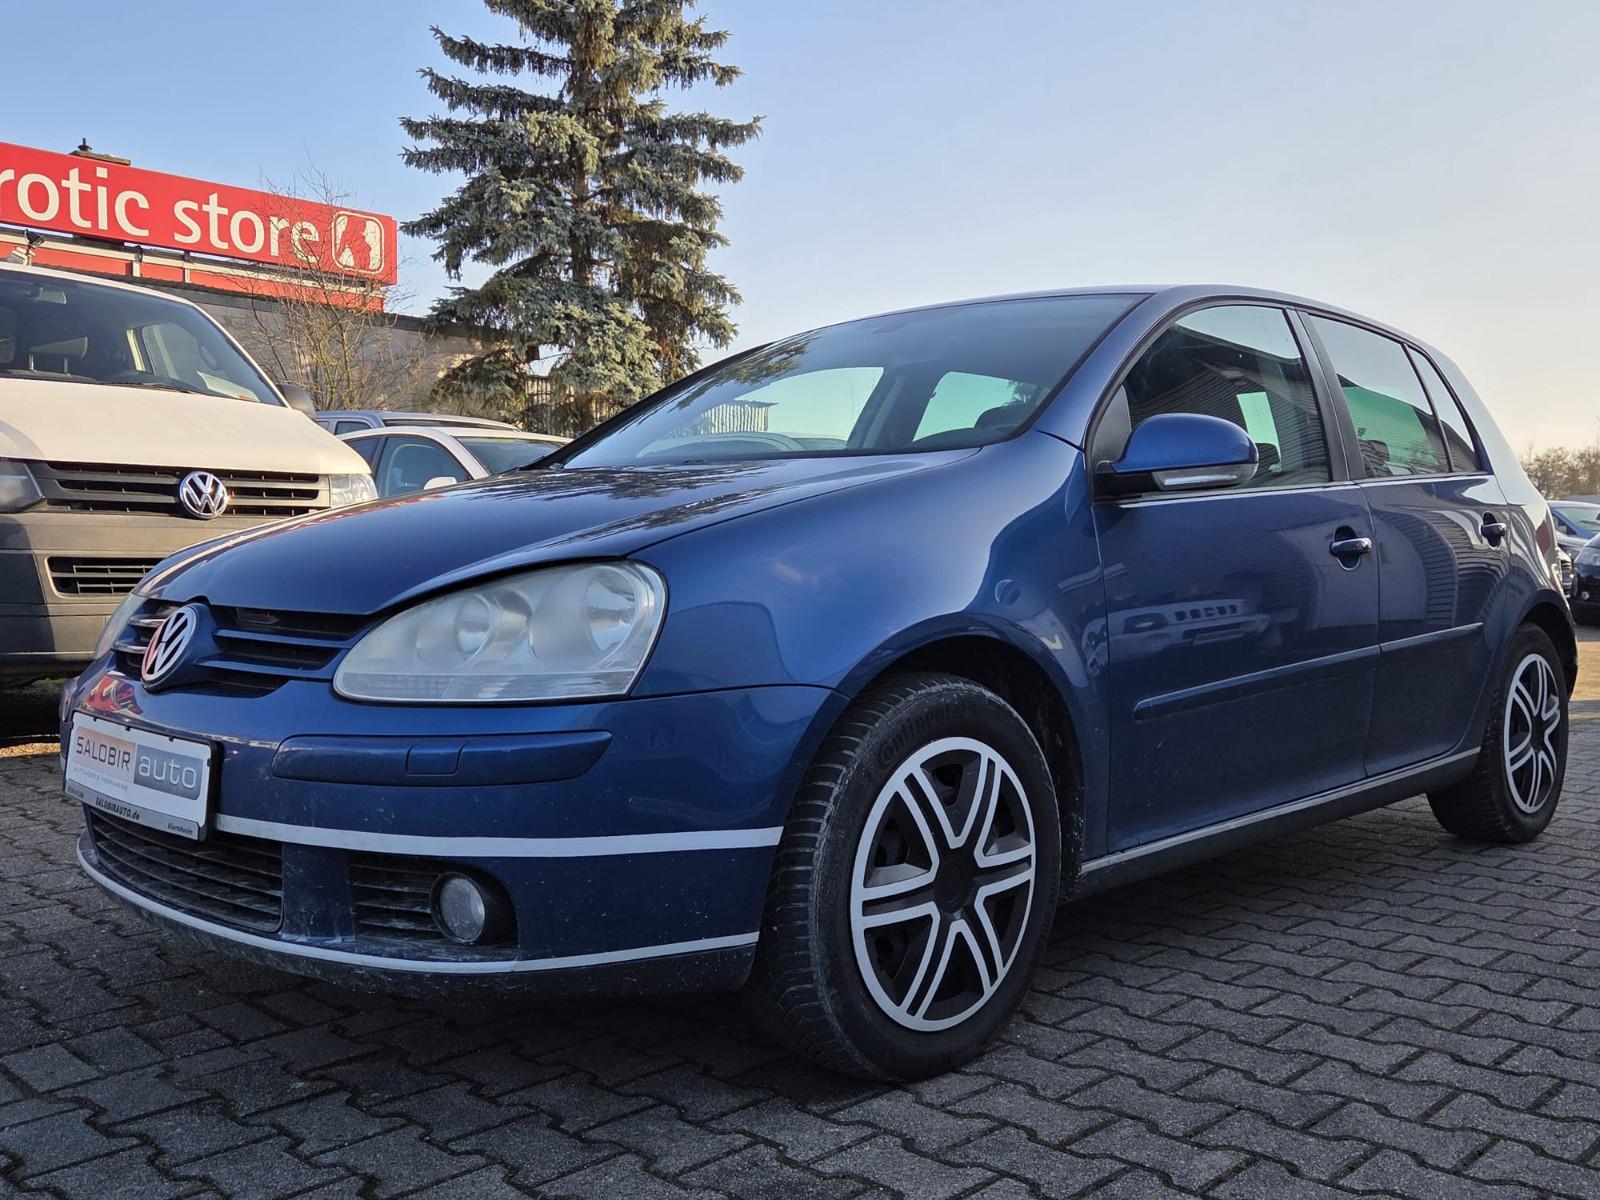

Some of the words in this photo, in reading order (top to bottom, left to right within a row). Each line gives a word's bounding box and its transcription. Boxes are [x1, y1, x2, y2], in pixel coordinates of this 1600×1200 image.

[174, 192, 320, 264] store
[76, 736, 131, 772] SALOBIR
[138, 756, 197, 789] auto
